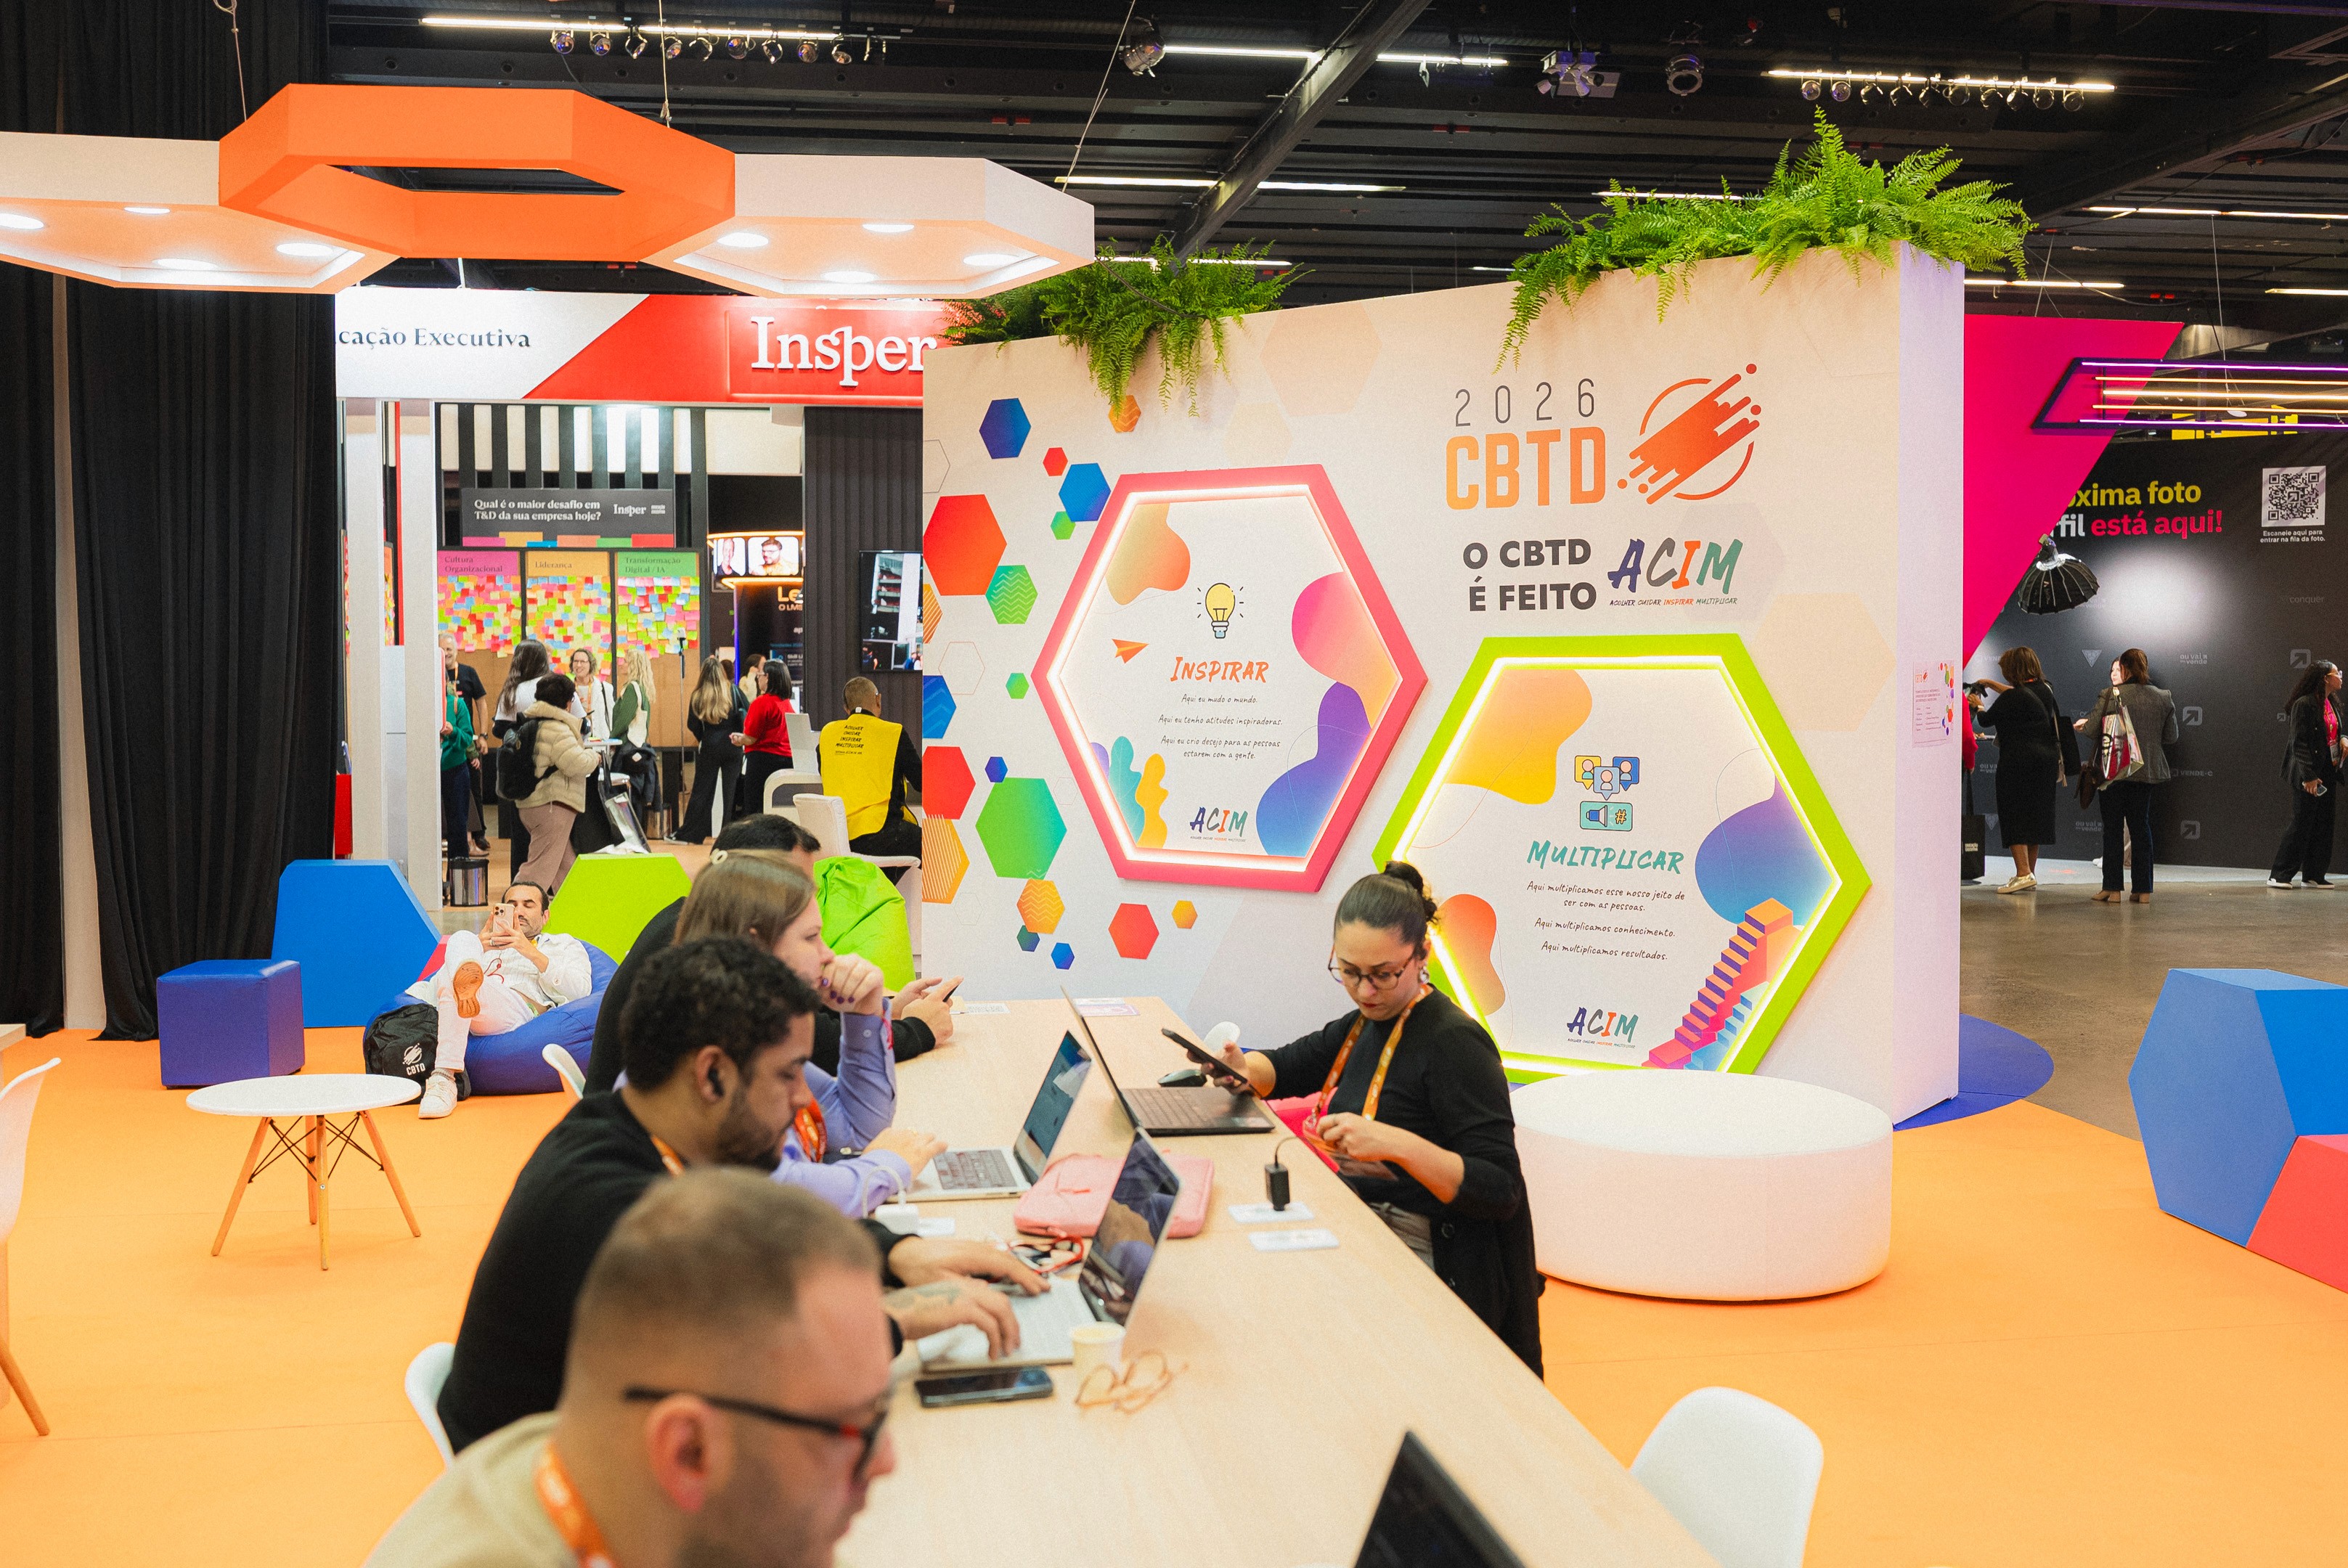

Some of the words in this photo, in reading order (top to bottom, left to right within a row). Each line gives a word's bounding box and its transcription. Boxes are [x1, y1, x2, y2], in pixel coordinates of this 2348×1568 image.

[336, 328, 407, 349] cação
[414, 328, 531, 347] Executiva
[750, 316, 937, 386] Insper
[1455, 378, 1595, 427] 2026
[1446, 426, 1606, 510] CBTD
[2148, 481, 2201, 504] foto
[474, 499, 498, 510] Qual
[517, 499, 546, 509] maior
[547, 499, 583, 509] desafio
[614, 504, 647, 517] Insper
[474, 511, 497, 520] T&D
[498, 511, 511, 520] da
[531, 513, 574, 522] empresa
[575, 511, 601, 522] hoje?
[2091, 510, 2148, 536] está
[2154, 510, 2222, 539] aqui!
[1463, 542, 1488, 569] O
[1499, 538, 1591, 568] CBTD
[1607, 537, 1743, 595] ACIM
[1469, 576, 1487, 612] É
[1499, 581, 1597, 611] FEITO
[1181, 693, 1196, 704] Aqui
[1207, 695, 1226, 703] mudo
[1158, 714, 1173, 725] Aqui
[1183, 716, 1204, 724] tenho
[1236, 717, 1283, 727] inspiradoras.
[1161, 735, 1175, 745] Aqui
[1202, 737, 1222, 748] desejo
[1234, 751, 1256, 761] gente.
[1190, 807, 1249, 837] ACIM
[1526, 881, 1545, 892] Aqui
[1547, 883, 1603, 896] multiplicamos
[1651, 890, 1672, 901] jeito
[1674, 891, 1685, 900] de
[1610, 902, 1646, 912] pessoas.
[1534, 918, 1552, 929] Aqui
[1554, 920, 1611, 933] multiplicamos
[1614, 924, 1676, 937] conhecimento.
[1541, 941, 1560, 952] Aqui
[1562, 944, 1618, 957] multiplicamos
[1621, 950, 1668, 960] resultados.
[1566, 1006, 1639, 1042] ACIM
[406, 1063, 426, 1076] CBTD
